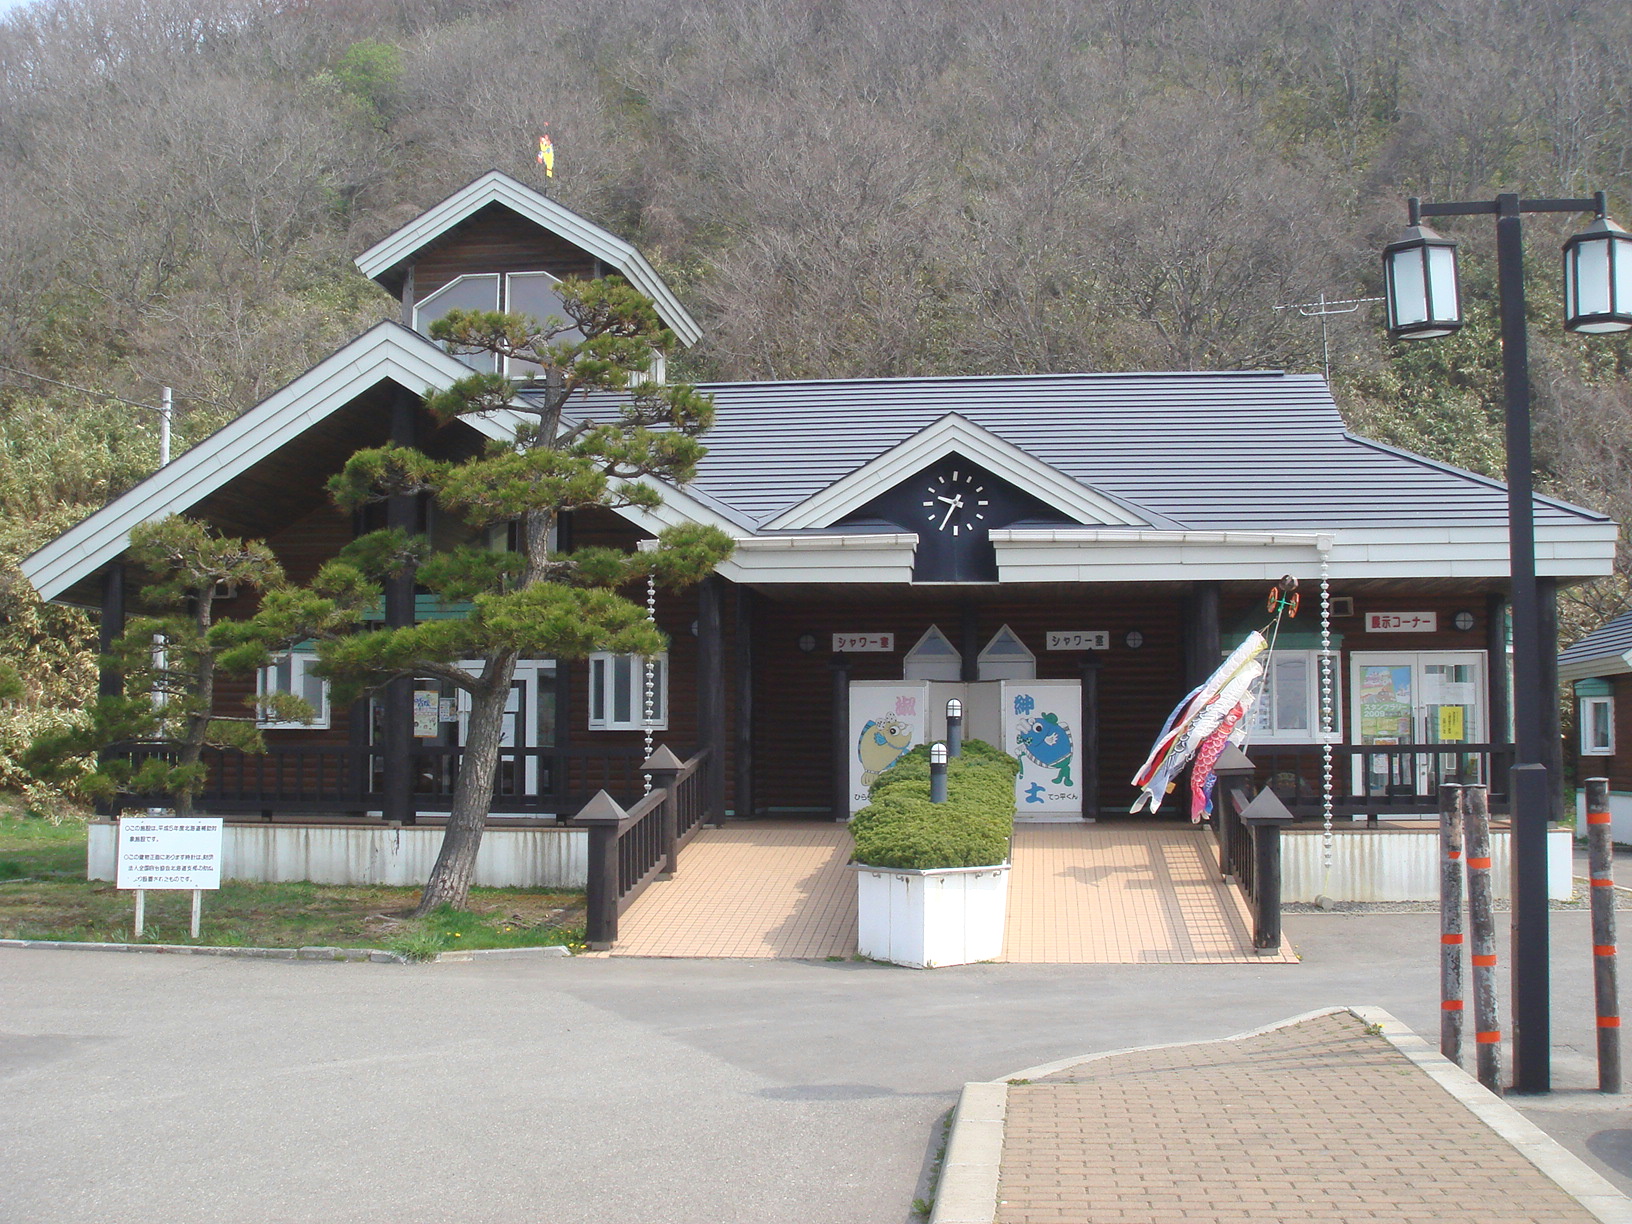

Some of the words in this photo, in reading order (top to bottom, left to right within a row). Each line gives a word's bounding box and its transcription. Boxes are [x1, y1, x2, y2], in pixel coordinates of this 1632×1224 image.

[1371, 615, 1431, 629] 展示コーナー
[838, 636, 889, 648] シャワー室
[1051, 634, 1104, 647] シャワー室
